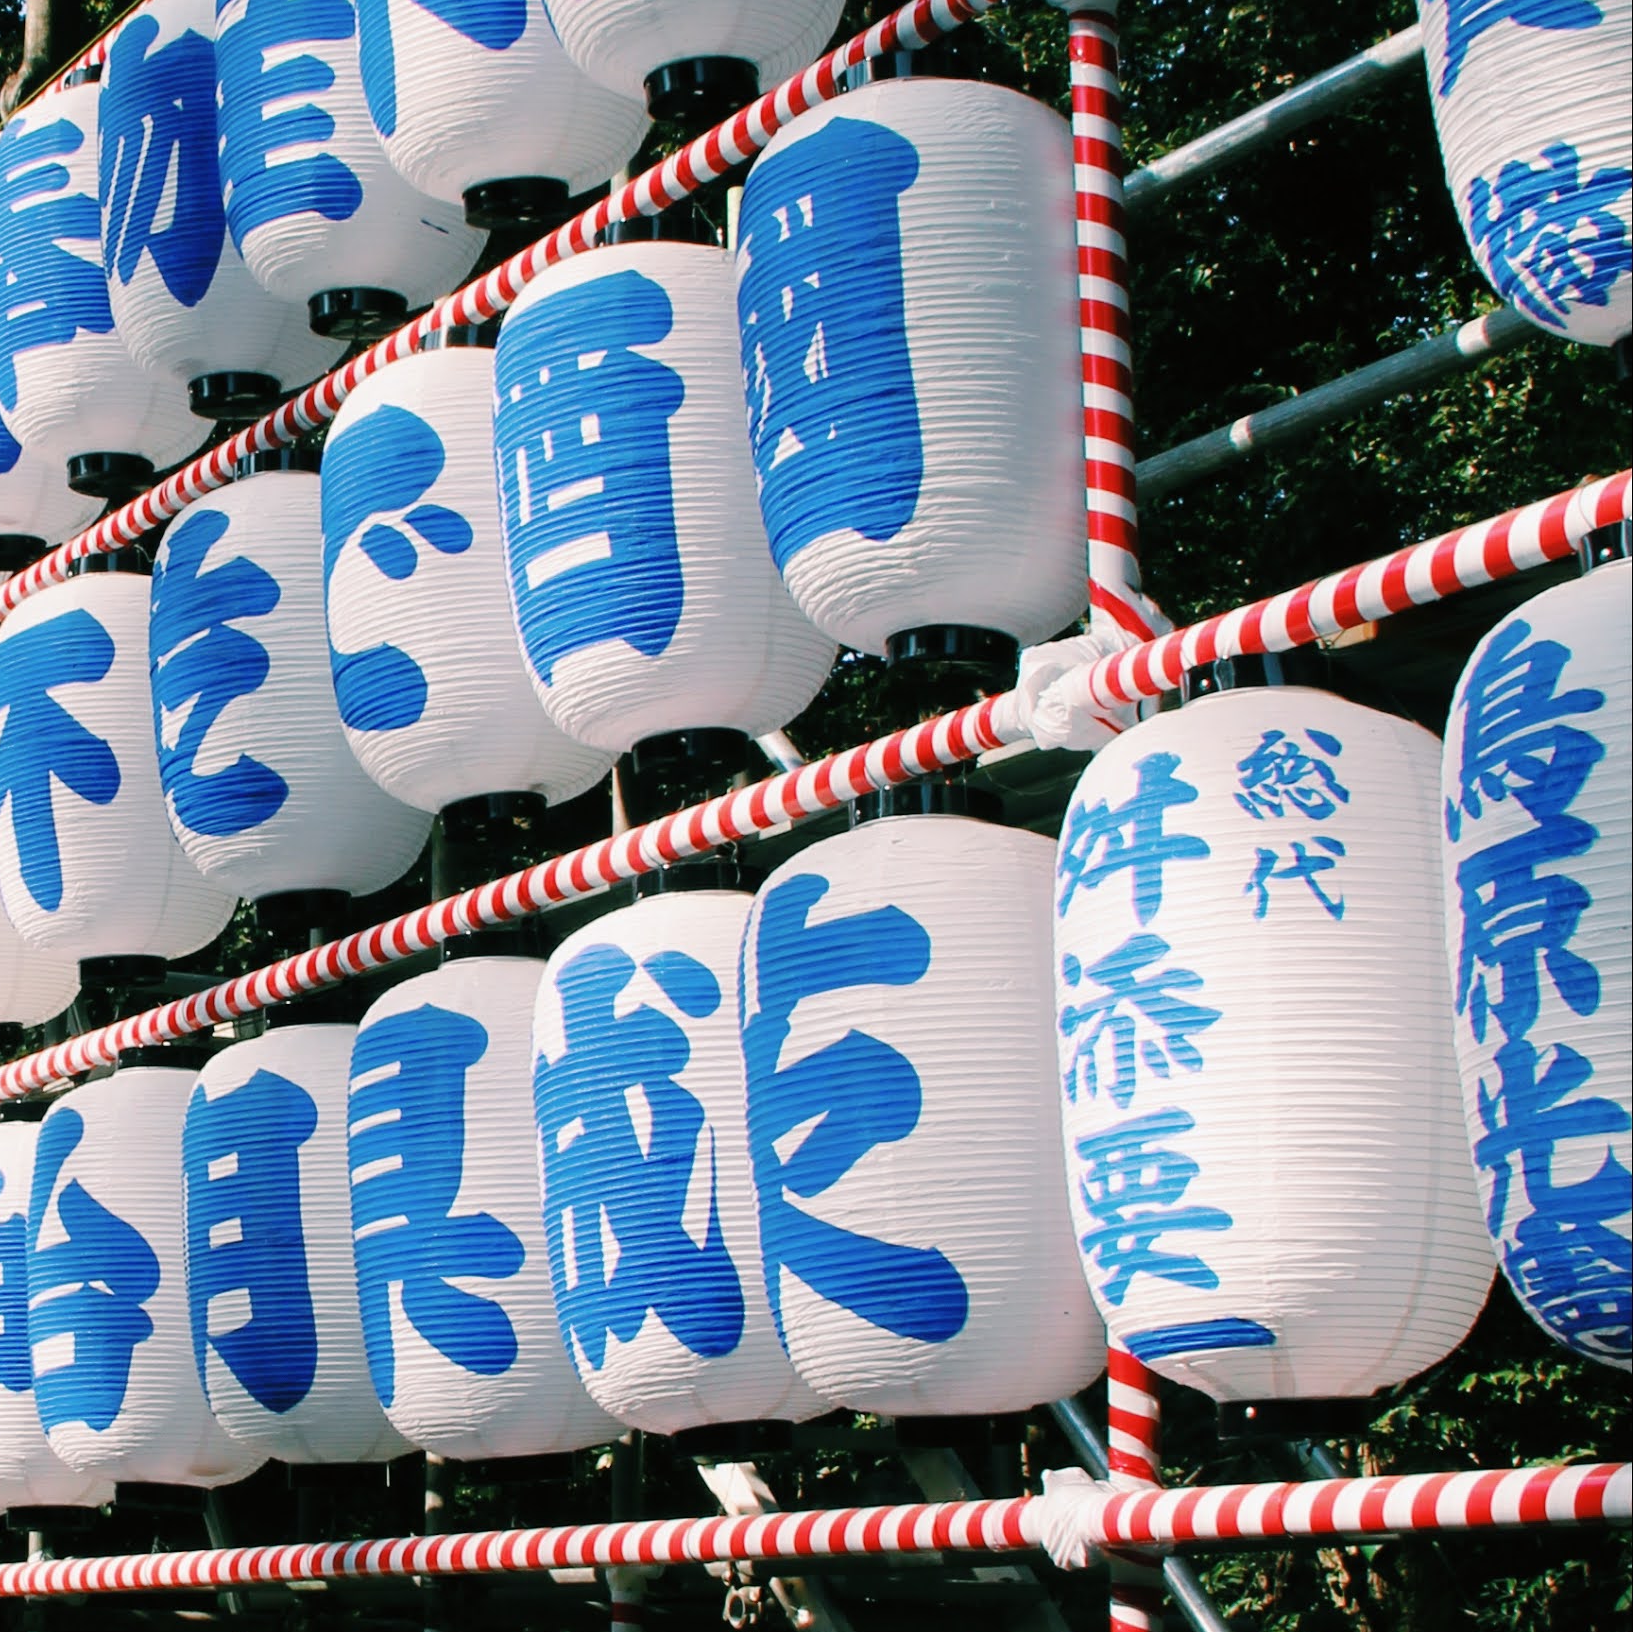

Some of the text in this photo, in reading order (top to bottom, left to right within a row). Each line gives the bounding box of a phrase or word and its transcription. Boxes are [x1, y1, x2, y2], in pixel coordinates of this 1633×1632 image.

[1234, 728, 1349, 921] 総代
[1056, 751, 1276, 1363] 舛添要一
